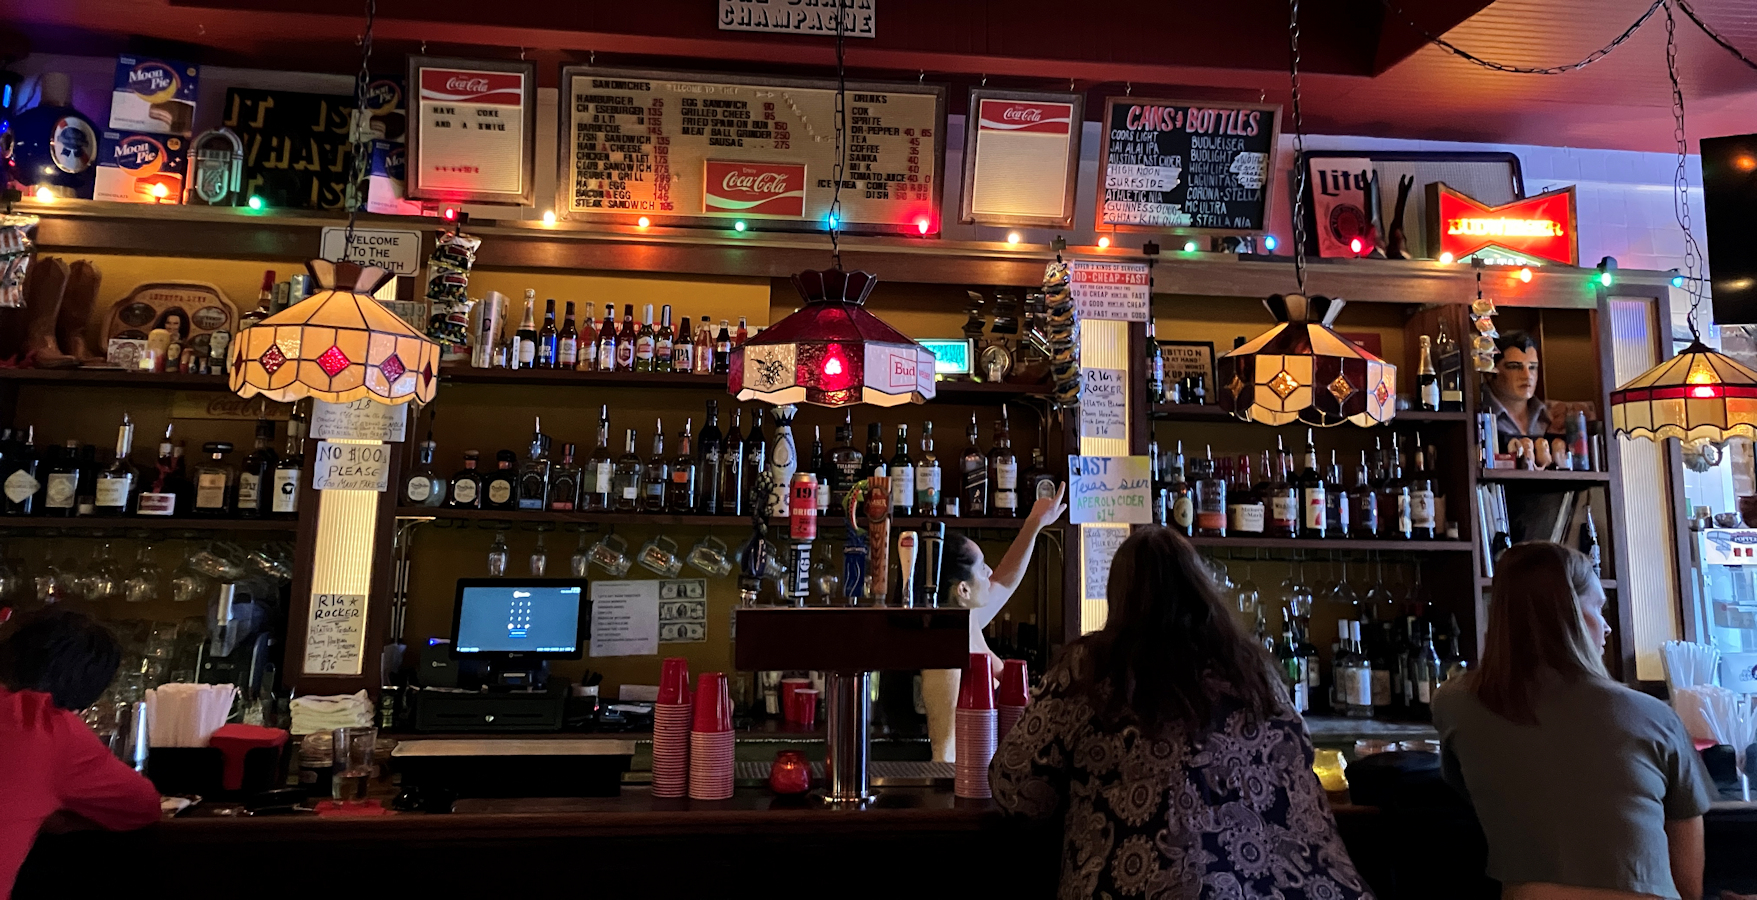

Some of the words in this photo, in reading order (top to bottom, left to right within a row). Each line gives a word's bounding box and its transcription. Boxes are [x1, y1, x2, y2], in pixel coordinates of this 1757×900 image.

[720, 4, 873, 34] CHAMPAGNE
[129, 68, 163, 83] Moon
[150, 76, 170, 90] Pie
[592, 79, 651, 92] SANDWICHES
[576, 94, 634, 106] HAMBURGER
[681, 97, 698, 108] EGG
[702, 99, 748, 110] SANDWICH
[852, 93, 888, 105] DRINKS
[433, 106, 455, 116] HAVE
[476, 109, 499, 118] COKE
[681, 107, 718, 118] GRILLED
[1003, 107, 1044, 122] Coca-Cola
[435, 120, 451, 129] AND
[462, 122, 468, 130] A
[682, 116, 709, 127] FRIED
[736, 119, 749, 129] ON
[851, 116, 882, 127] SPRITE
[1126, 105, 1176, 132] CANS
[1185, 107, 1261, 137] BOTTLES
[577, 123, 621, 134] BARBECUE
[681, 126, 705, 137] MEAT
[711, 126, 733, 138] BALL
[736, 128, 772, 140] GRINDER
[577, 132, 597, 143] FISH
[604, 134, 652, 145] SANDWICH
[851, 135, 867, 145] TEA
[1111, 129, 1134, 141] COORS
[1136, 131, 1159, 142] LIGHT
[577, 142, 597, 152] HAM
[610, 143, 643, 154] CHEESE
[850, 144, 880, 155] COFFEE
[1146, 142, 1160, 155] IPA
[1191, 135, 1245, 152] BUDWEISER
[114, 143, 149, 158] Moon
[136, 150, 156, 164] Pie
[849, 153, 878, 163] SANKA
[1159, 155, 1182, 168] CIDER
[575, 160, 599, 171] CLUB
[603, 162, 652, 174] SANDWICH
[1111, 165, 1133, 175] HIGH
[1136, 166, 1160, 177] NOON
[617, 172, 644, 182] GRILL
[722, 170, 790, 194] Coca-Cola
[850, 171, 883, 181] TOMATO
[1188, 174, 1238, 188] LAGUNITAS
[608, 181, 626, 191] EGG
[817, 179, 832, 189] ICE
[1107, 177, 1165, 189] SURFSIDE
[1317, 169, 1364, 197] Lite
[613, 190, 631, 201] EGG
[865, 191, 889, 200] DISH
[1105, 190, 1147, 202] ATHLETIC
[1187, 187, 1220, 201] CORONA
[1223, 187, 1262, 203] STELLA
[574, 198, 603, 209] STEAK
[607, 200, 655, 211] SANDWICH
[1106, 202, 1154, 213] GUINNESS
[1200, 201, 1227, 215] ULTRA
[1196, 213, 1231, 228] STELLA
[352, 246, 366, 257] TO
[368, 247, 390, 258] THE
[1092, 272, 1120, 283] CHEAP
[1125, 274, 1147, 285] FAST
[1089, 290, 1108, 298] CHEAP
[1131, 292, 1146, 300] FAST
[1126, 301, 1146, 309] CHEAP
[1131, 311, 1147, 319] GOOD
[675, 348, 690, 361] IPA
[894, 361, 915, 377] Bud
[1084, 383, 1124, 396] ROCKER
[319, 445, 342, 462] NO
[328, 465, 381, 478] PLEASE
[1070, 456, 1112, 476] EAST
[1117, 495, 1145, 508] CIDER
[318, 594, 345, 608] RIG
[314, 608, 360, 621] ROCKER
